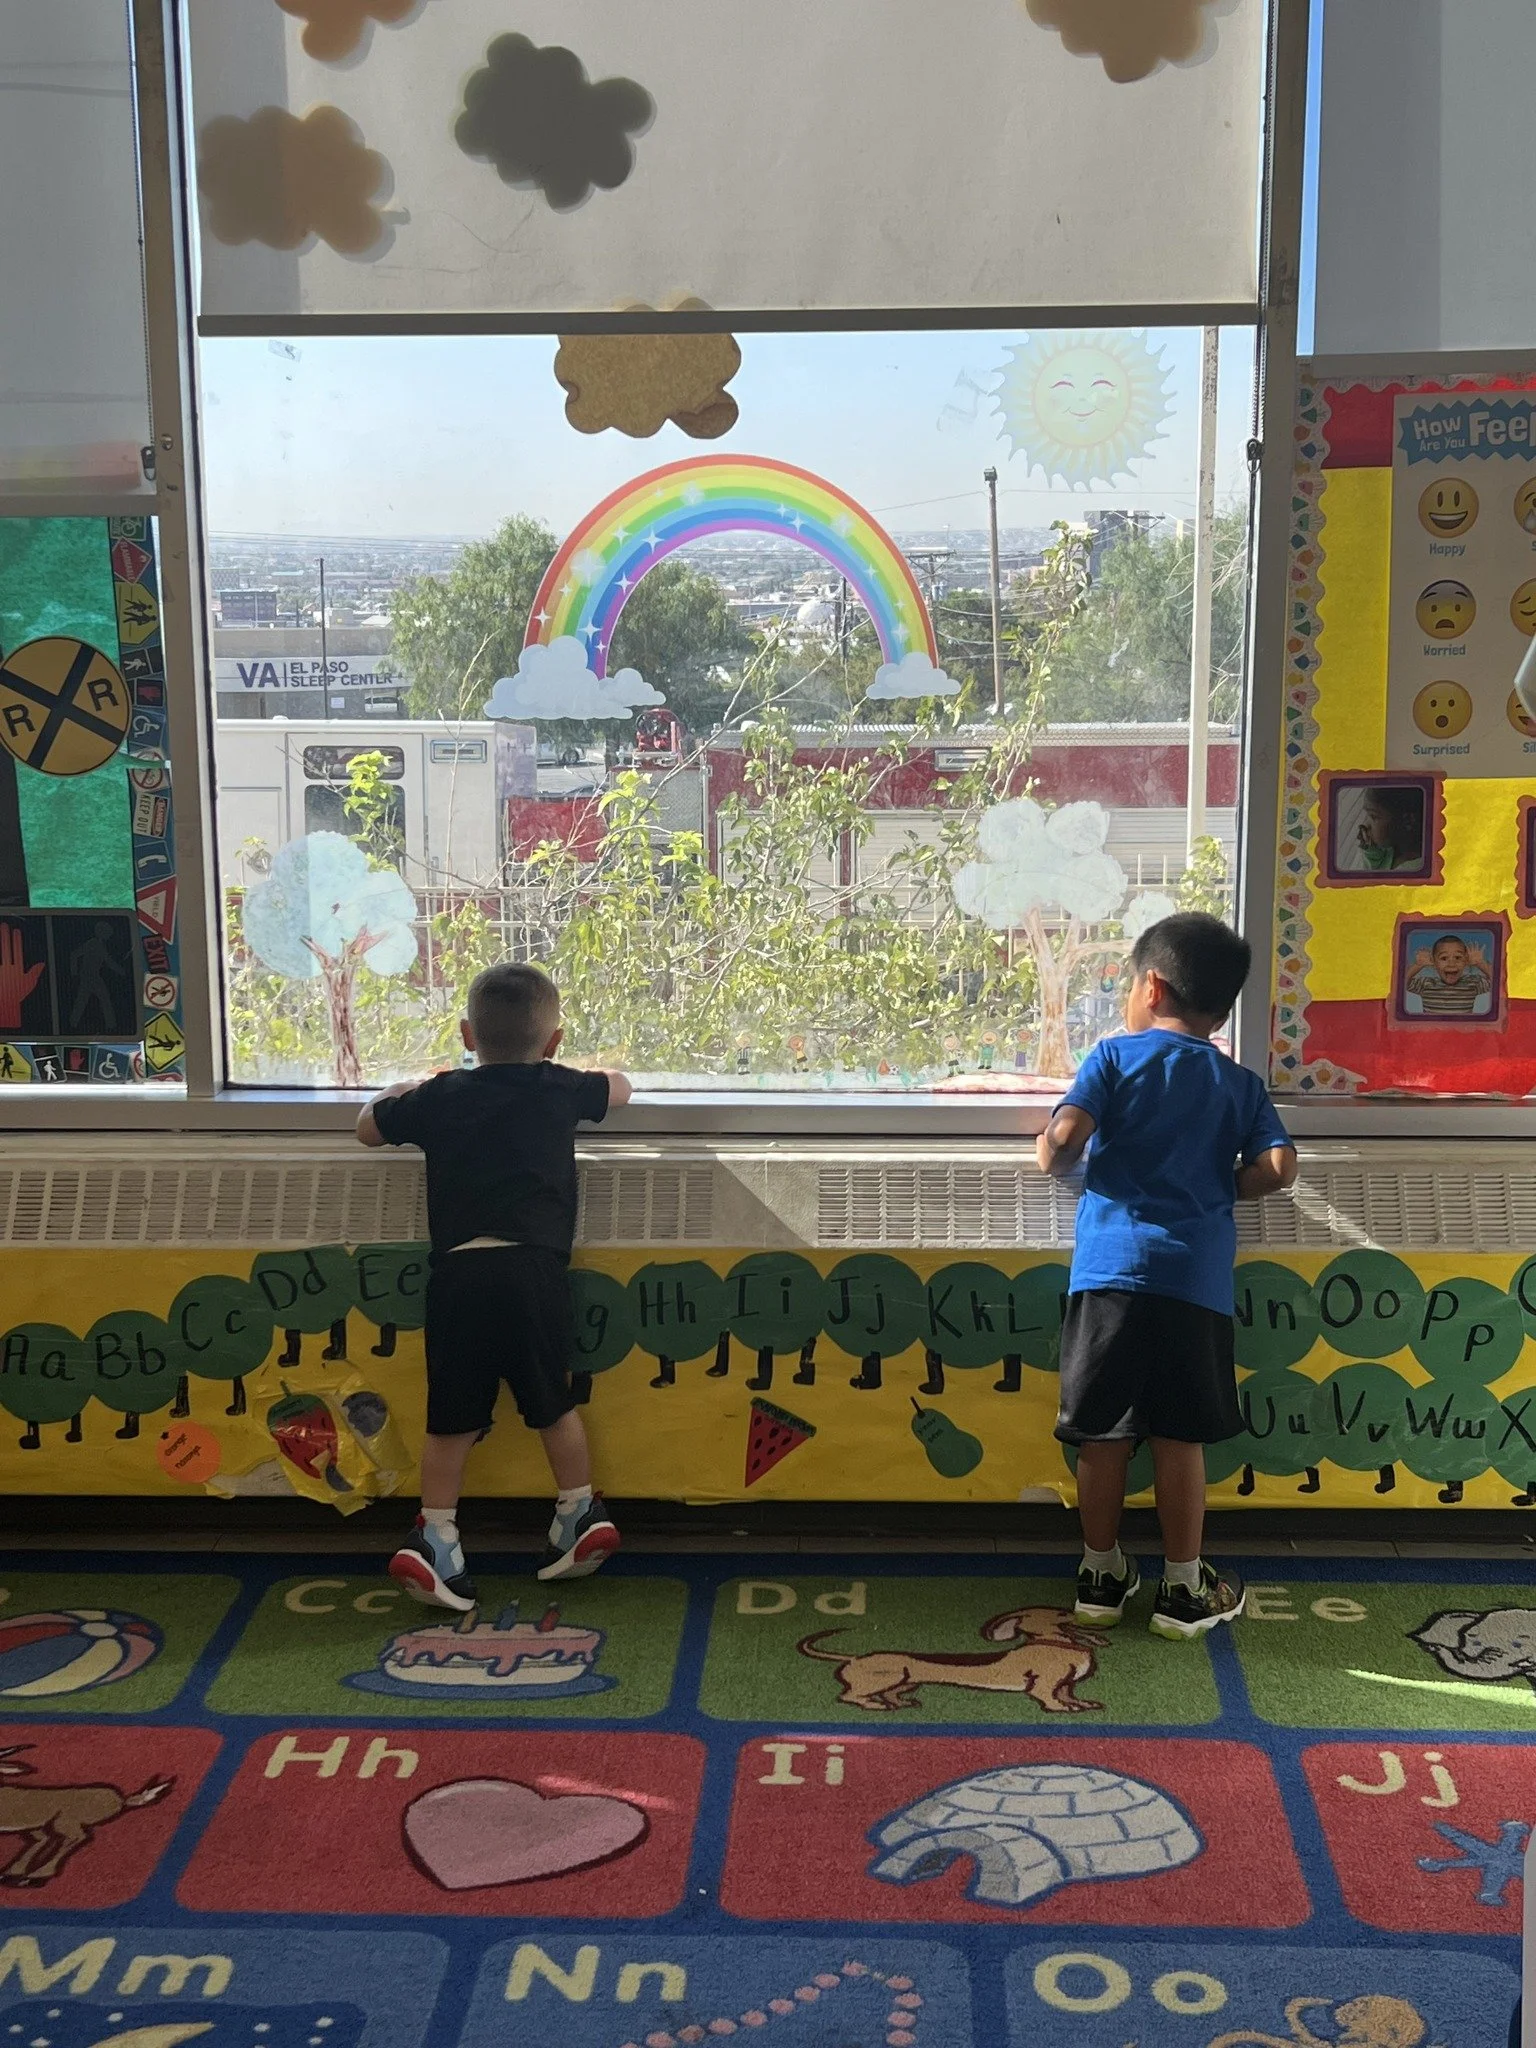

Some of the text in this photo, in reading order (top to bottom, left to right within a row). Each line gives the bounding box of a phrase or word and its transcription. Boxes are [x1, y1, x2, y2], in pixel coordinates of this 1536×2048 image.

[1413, 416, 1461, 439] How
[1419, 436, 1466, 452] Are You
[1429, 542, 1467, 557] Happy
[1423, 643, 1466, 656] Worried
[236, 662, 281, 688] VA
[290, 661, 349, 674] EL PASO
[290, 675, 336, 688] SLEEP
[2, 677, 120, 738] R R
[1412, 742, 1471, 758] Surprised
[136, 793, 151, 834] KEEP OUT
[152, 896, 160, 918] YIELD
[144, 934, 170, 971] EXIT
[263, 1735, 420, 1779] Hh
[503, 1943, 688, 2002] Nn
